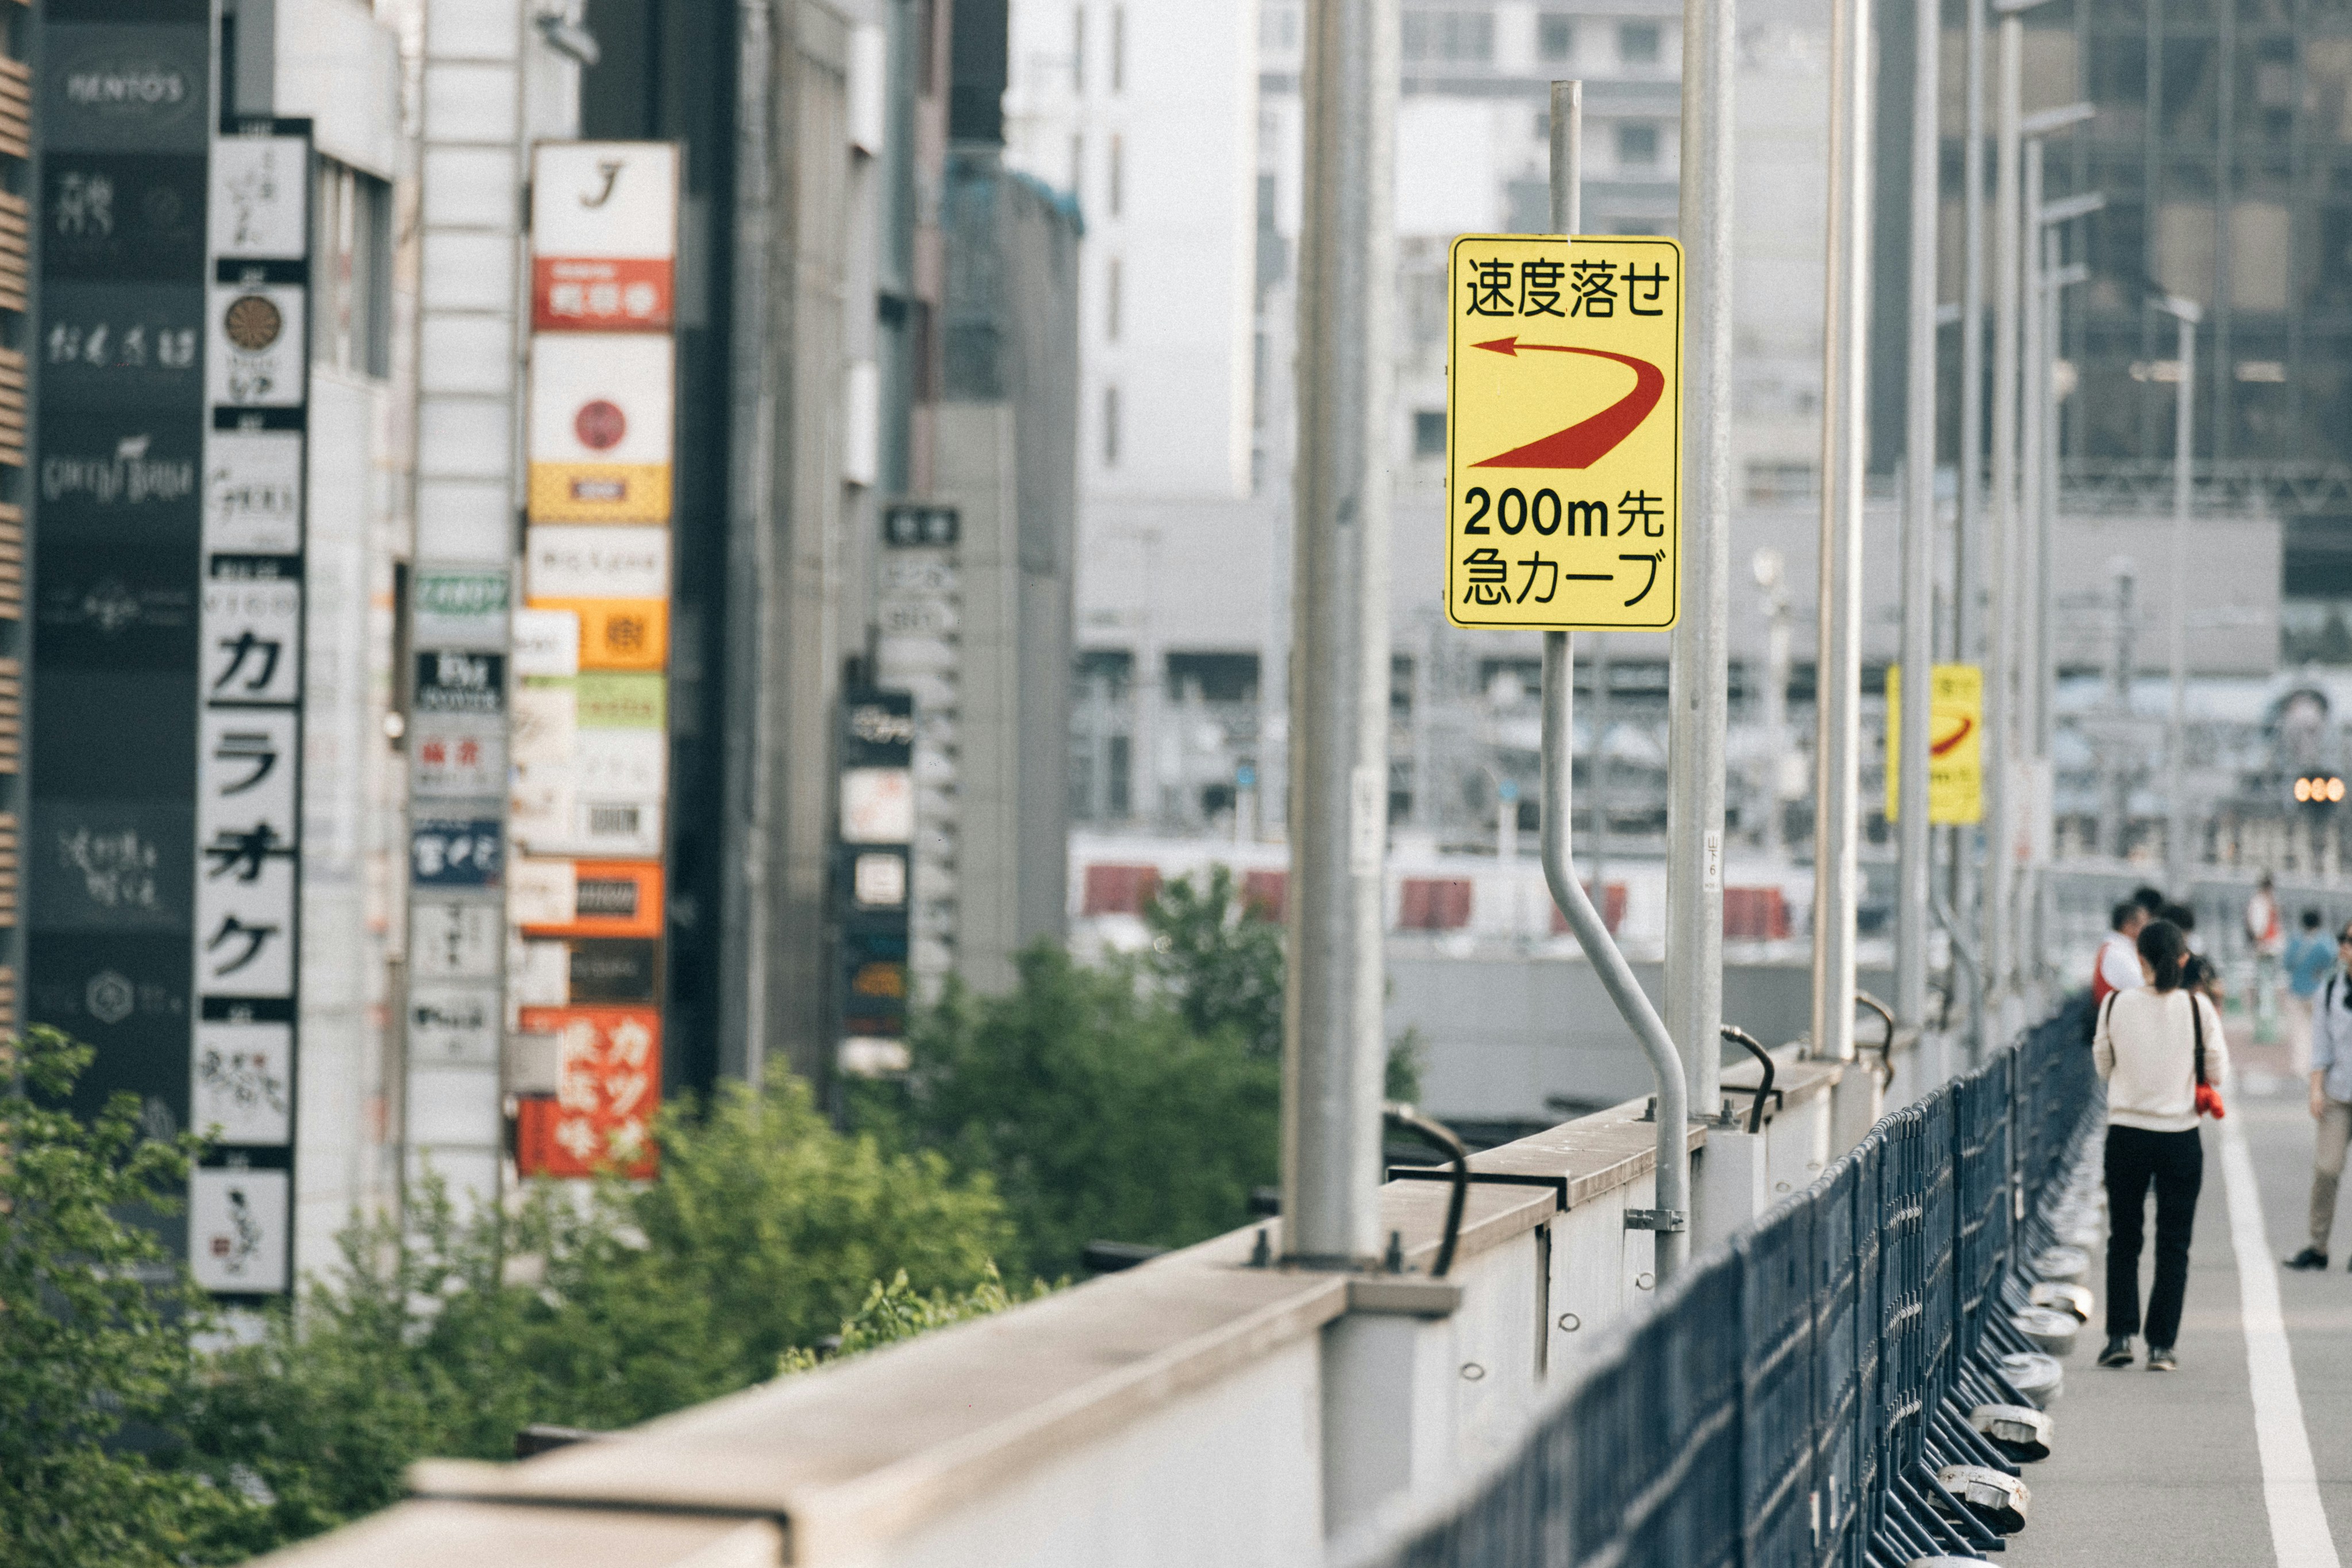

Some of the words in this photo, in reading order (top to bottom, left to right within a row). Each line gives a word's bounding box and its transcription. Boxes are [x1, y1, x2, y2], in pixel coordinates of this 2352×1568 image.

[1466, 257, 1670, 318] 速度落せ
[1463, 486, 1665, 537] 200m先
[1463, 548, 1666, 607] 急カーブ
[207, 630, 283, 977] カラオケ
